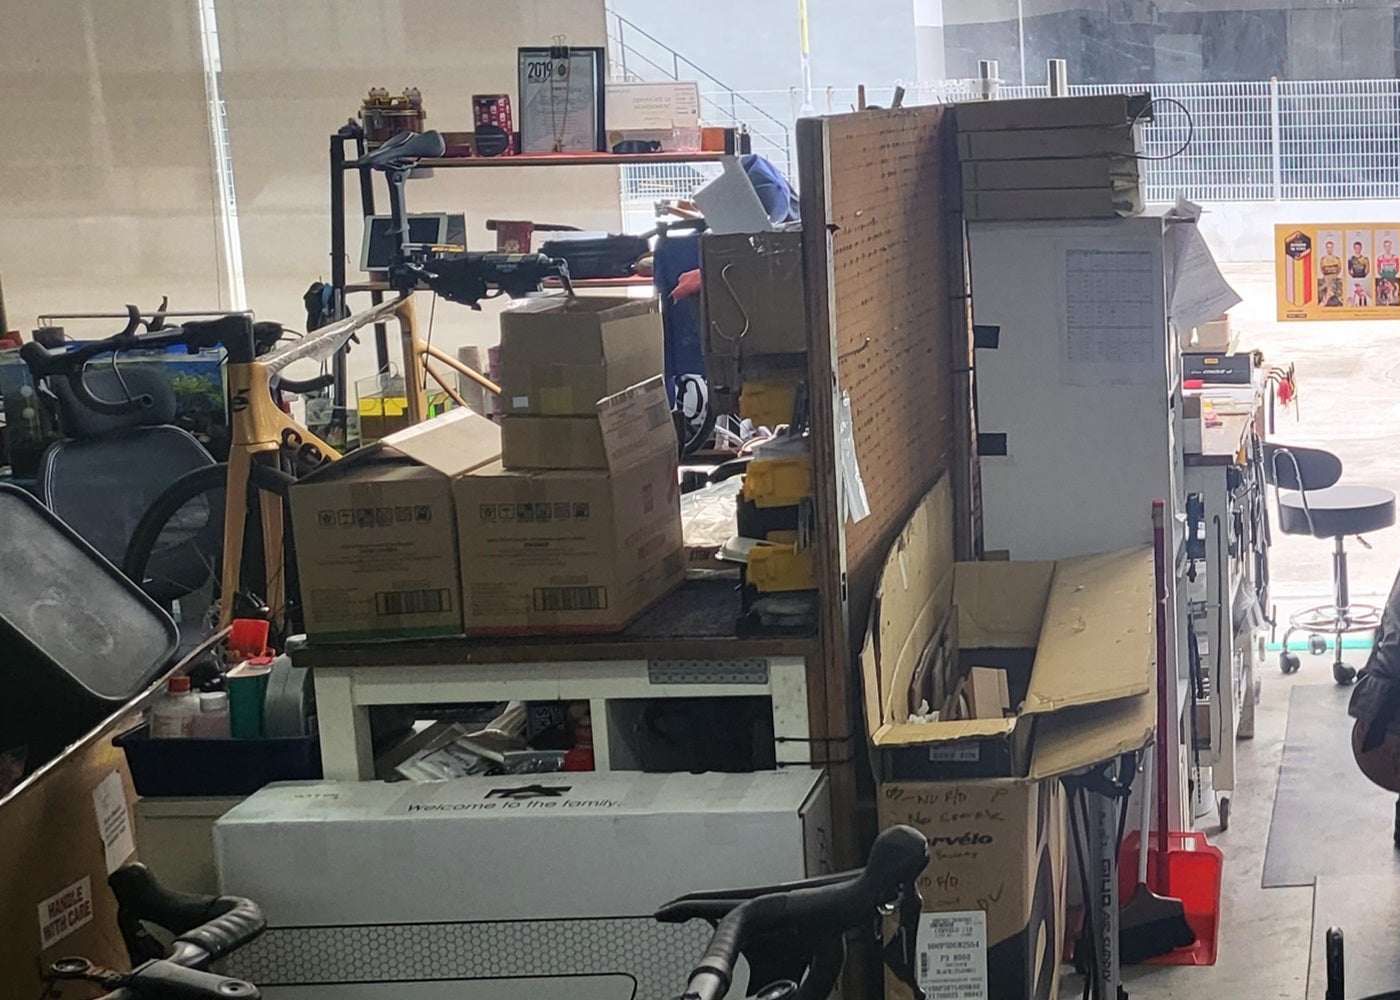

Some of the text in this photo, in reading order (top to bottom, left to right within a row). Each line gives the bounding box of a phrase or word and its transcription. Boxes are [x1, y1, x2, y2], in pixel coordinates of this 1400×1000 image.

[527, 61, 554, 79] 2019
[407, 802, 497, 813] Welcome
[502, 800, 522, 809] to
[526, 800, 558, 809] the
[927, 832, 993, 847] rvélo
[47, 885, 84, 918] HANDLE
[43, 901, 91, 940] WITH CARE
